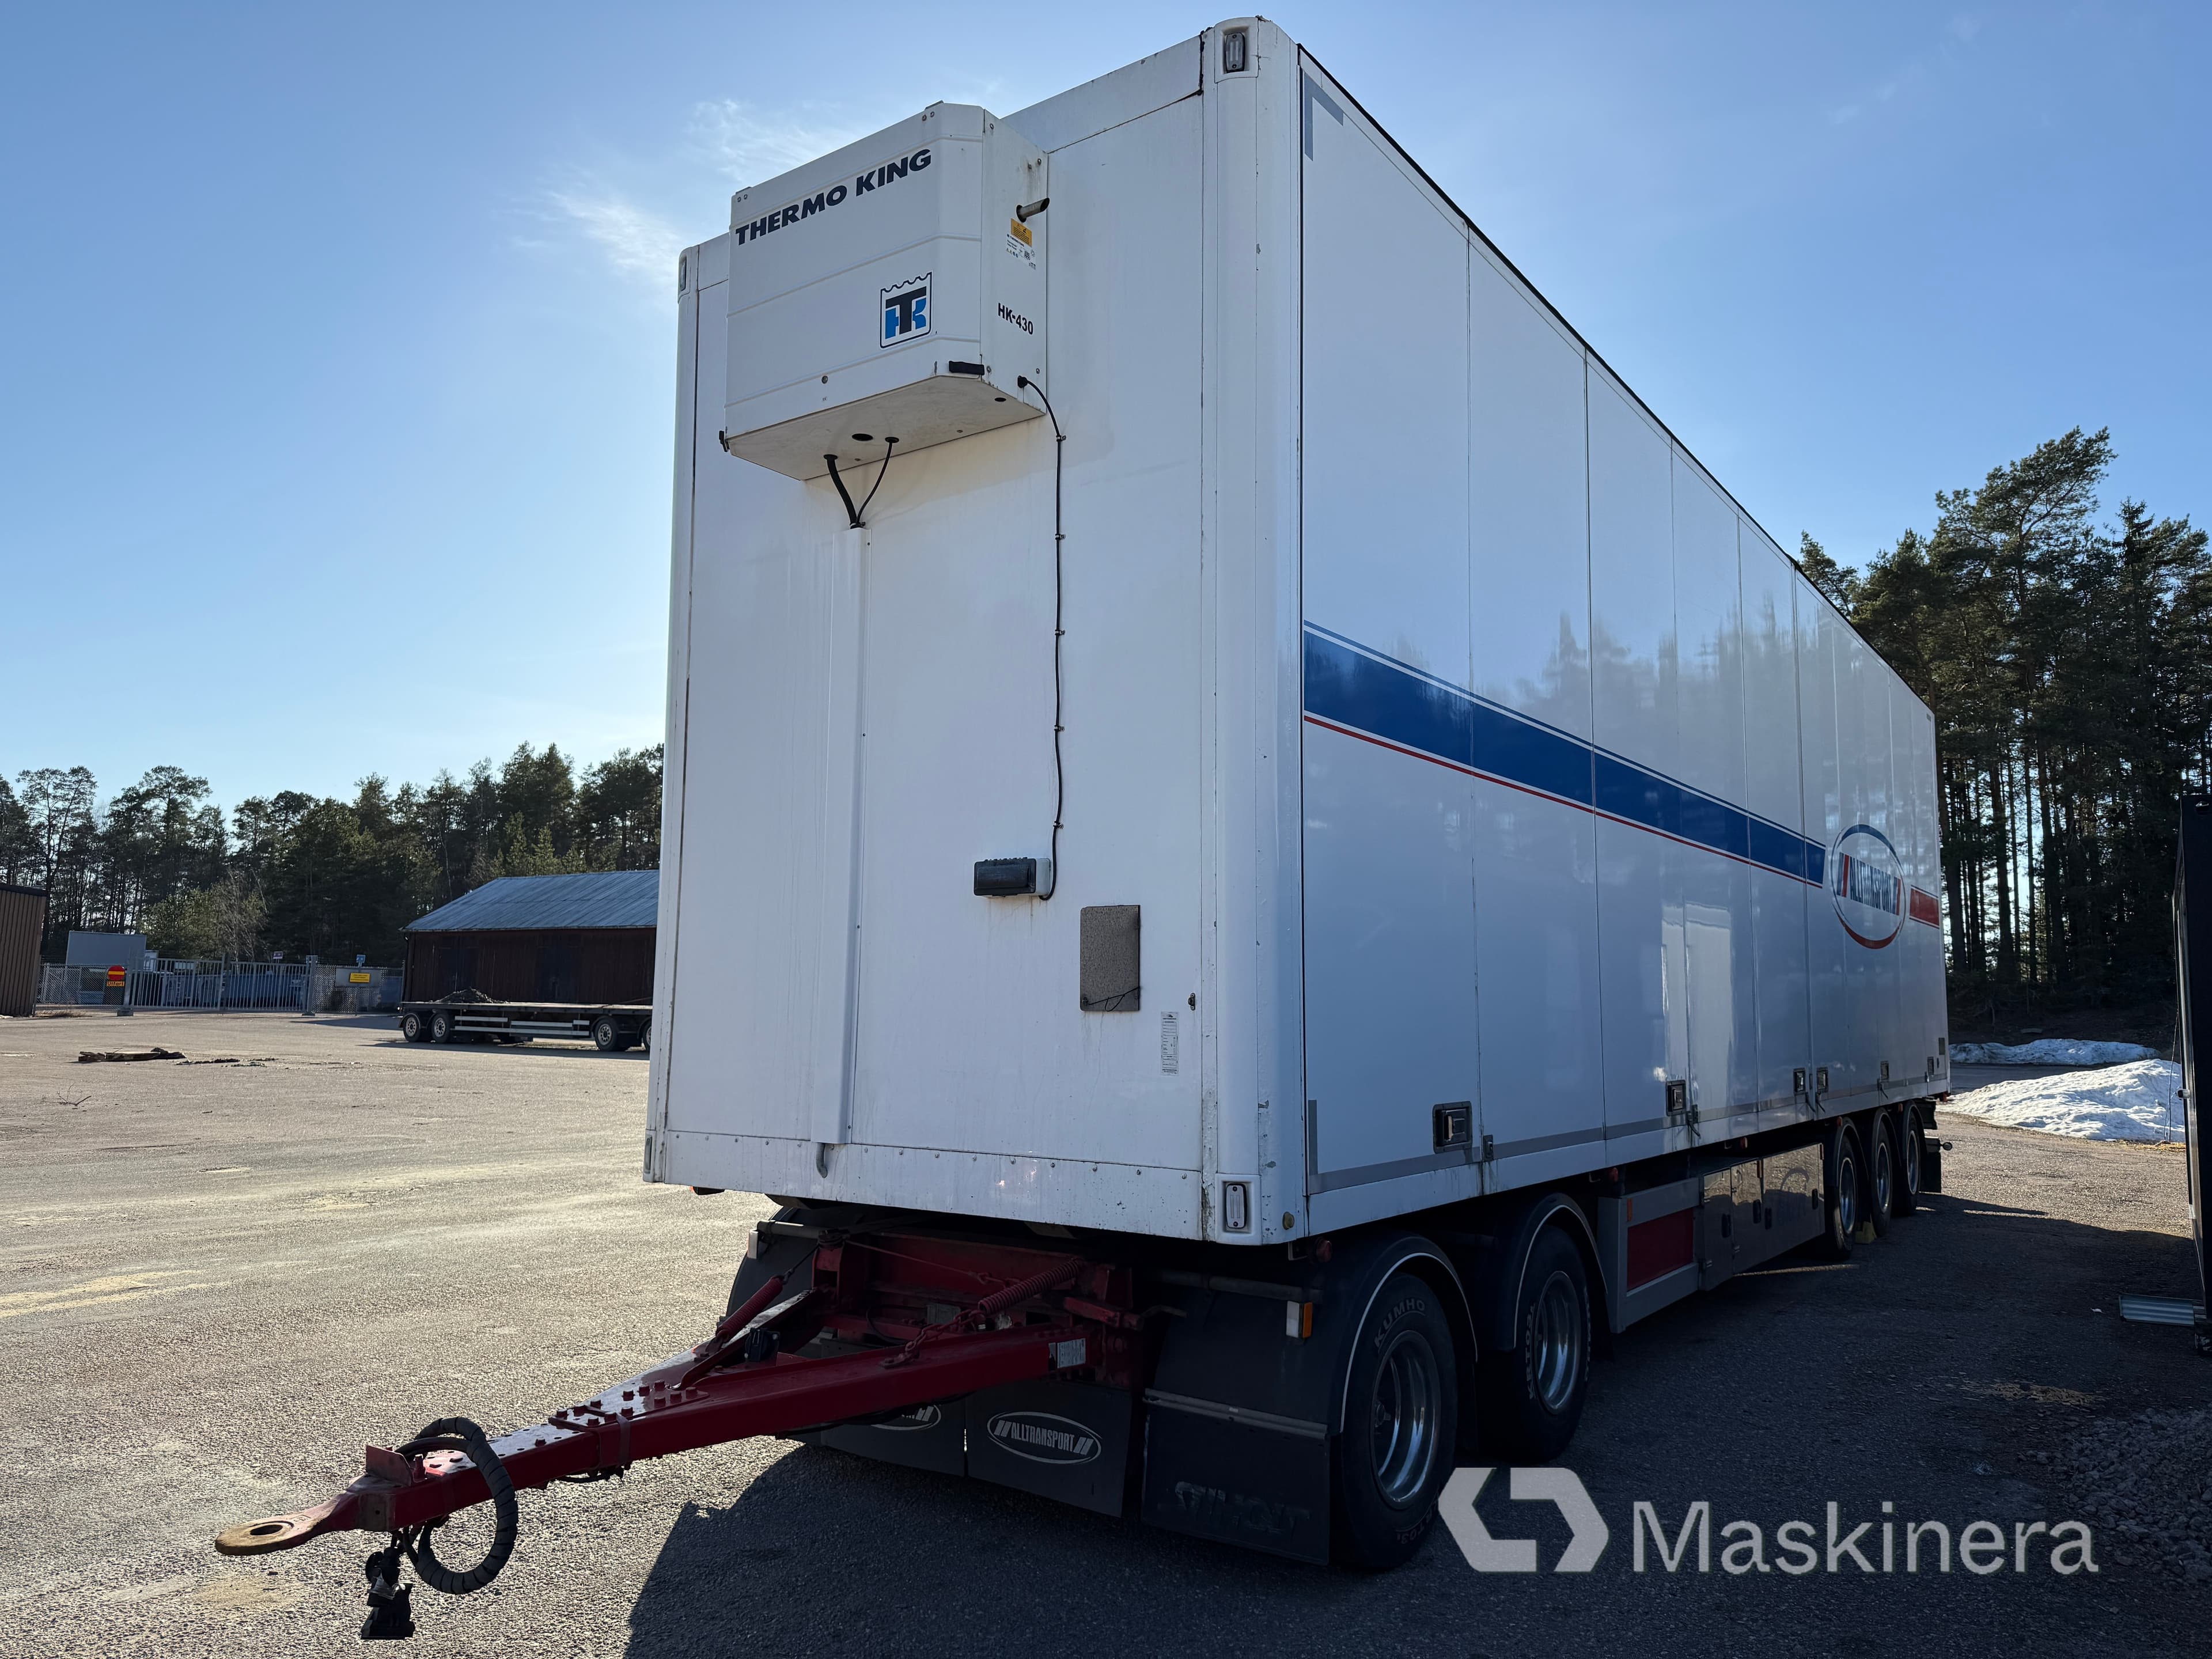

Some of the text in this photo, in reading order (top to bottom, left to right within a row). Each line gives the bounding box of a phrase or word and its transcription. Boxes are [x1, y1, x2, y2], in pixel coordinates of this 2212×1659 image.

[736, 149, 932, 245] THERMO KING
[998, 302, 1033, 335] HK-430
[1374, 1298, 1426, 1347] KUMHO
[1010, 1422, 1075, 1453] ALLTRANSPORT
